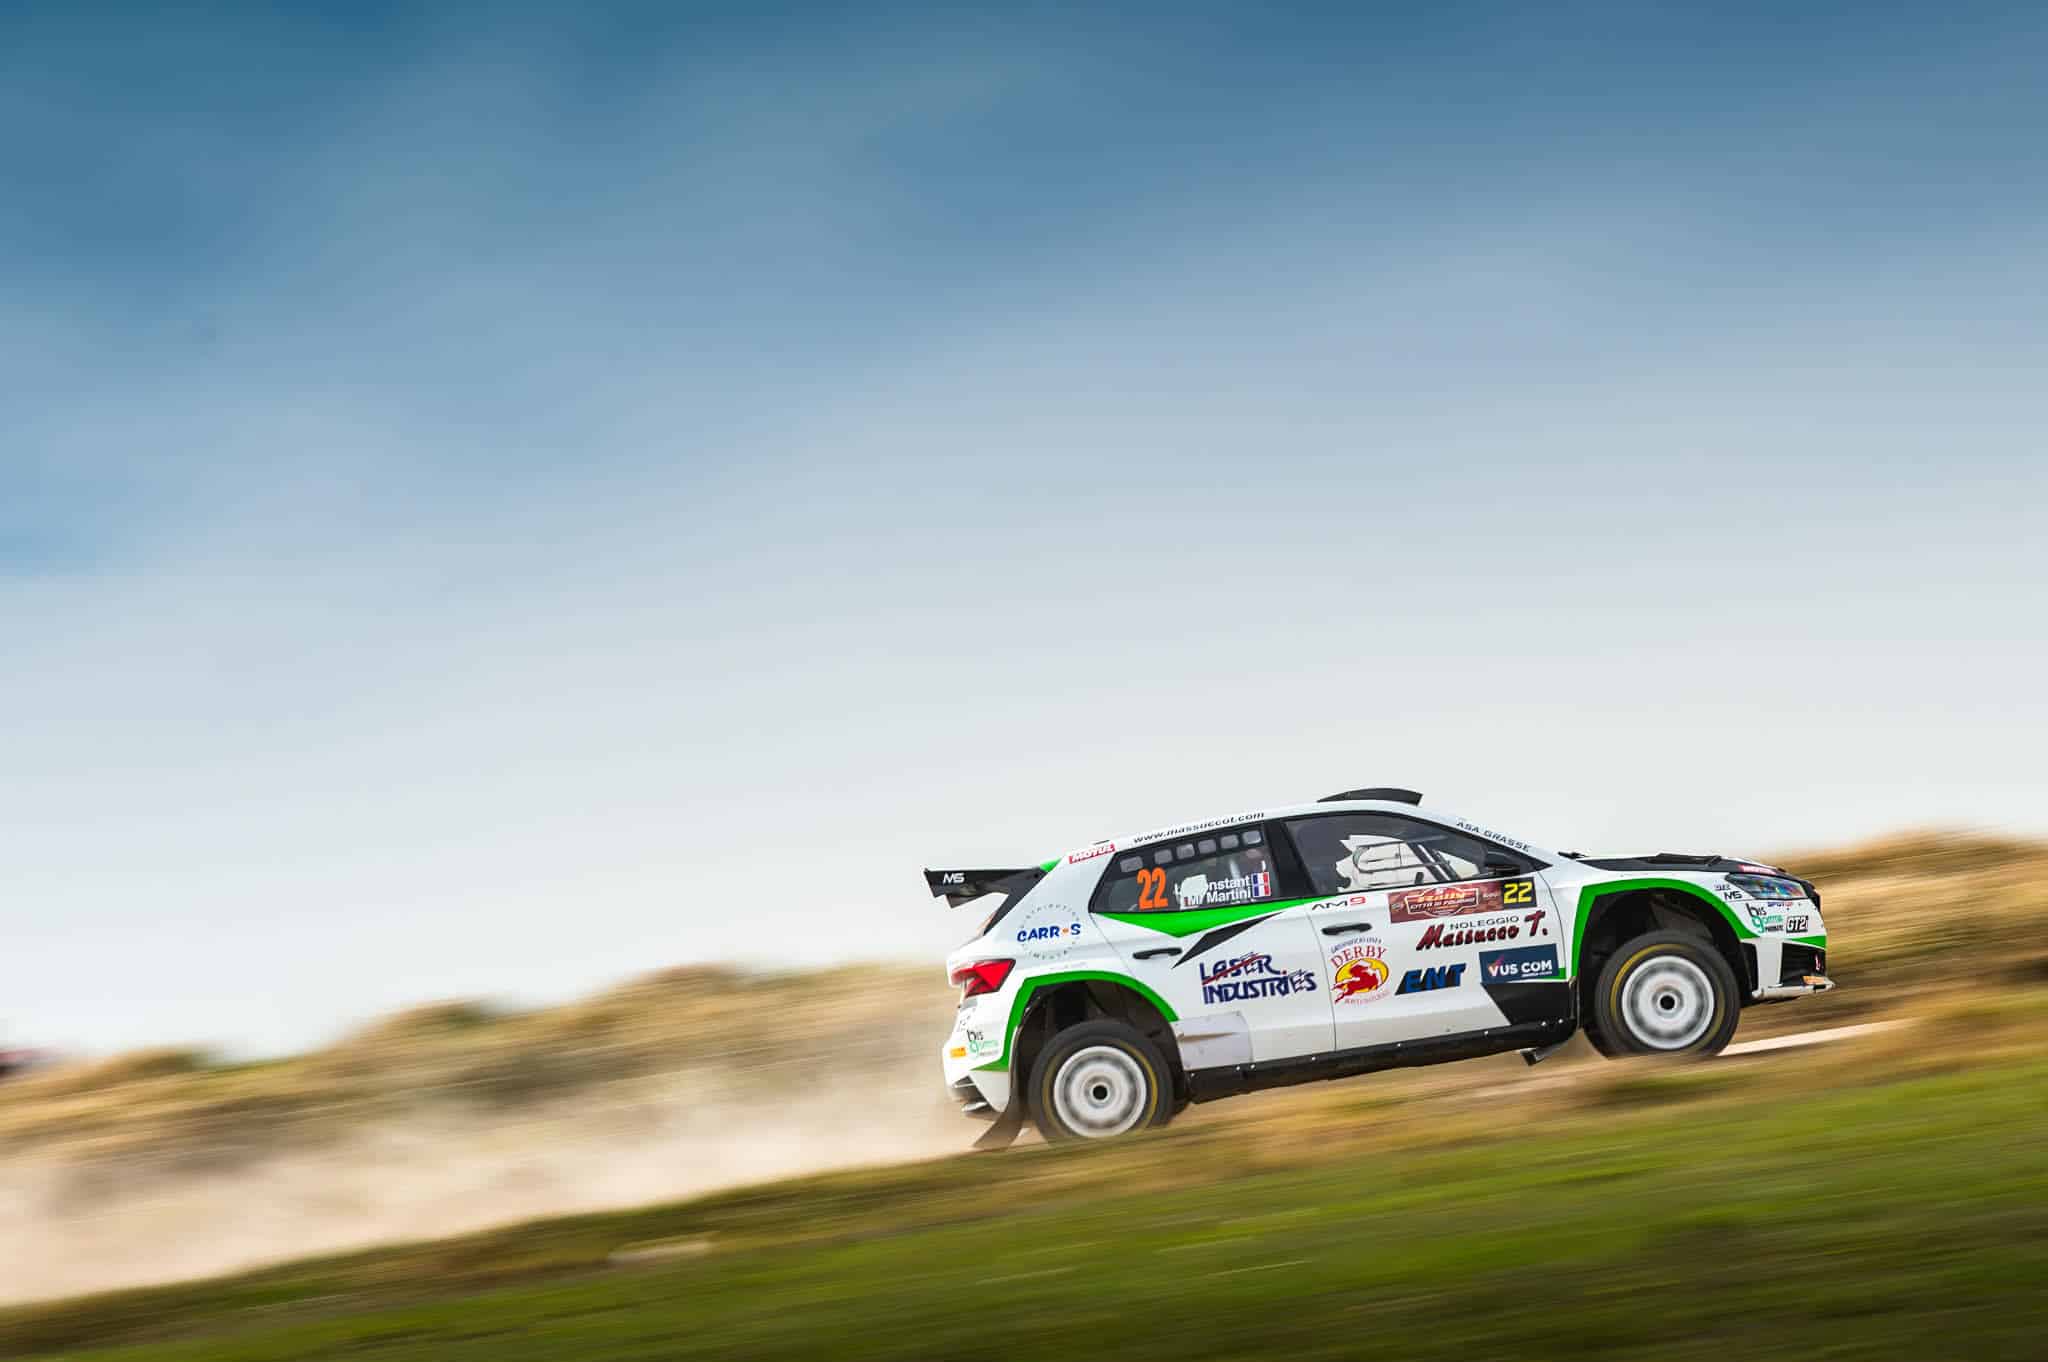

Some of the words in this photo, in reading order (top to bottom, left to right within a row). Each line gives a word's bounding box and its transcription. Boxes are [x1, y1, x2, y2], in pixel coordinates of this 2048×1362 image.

[1456, 821, 1480, 833] ASA
[1484, 830, 1531, 852] GRASSE
[1137, 867, 1169, 910] 22
[1206, 875, 1250, 891] nstant
[1503, 881, 1533, 904] 22
[1206, 887, 1251, 903] Martini
[1450, 916, 1519, 930] NOLEGGIO
[1416, 924, 1520, 950] Massucco
[1331, 945, 1387, 968] DERBY
[1521, 959, 1553, 974] COM
